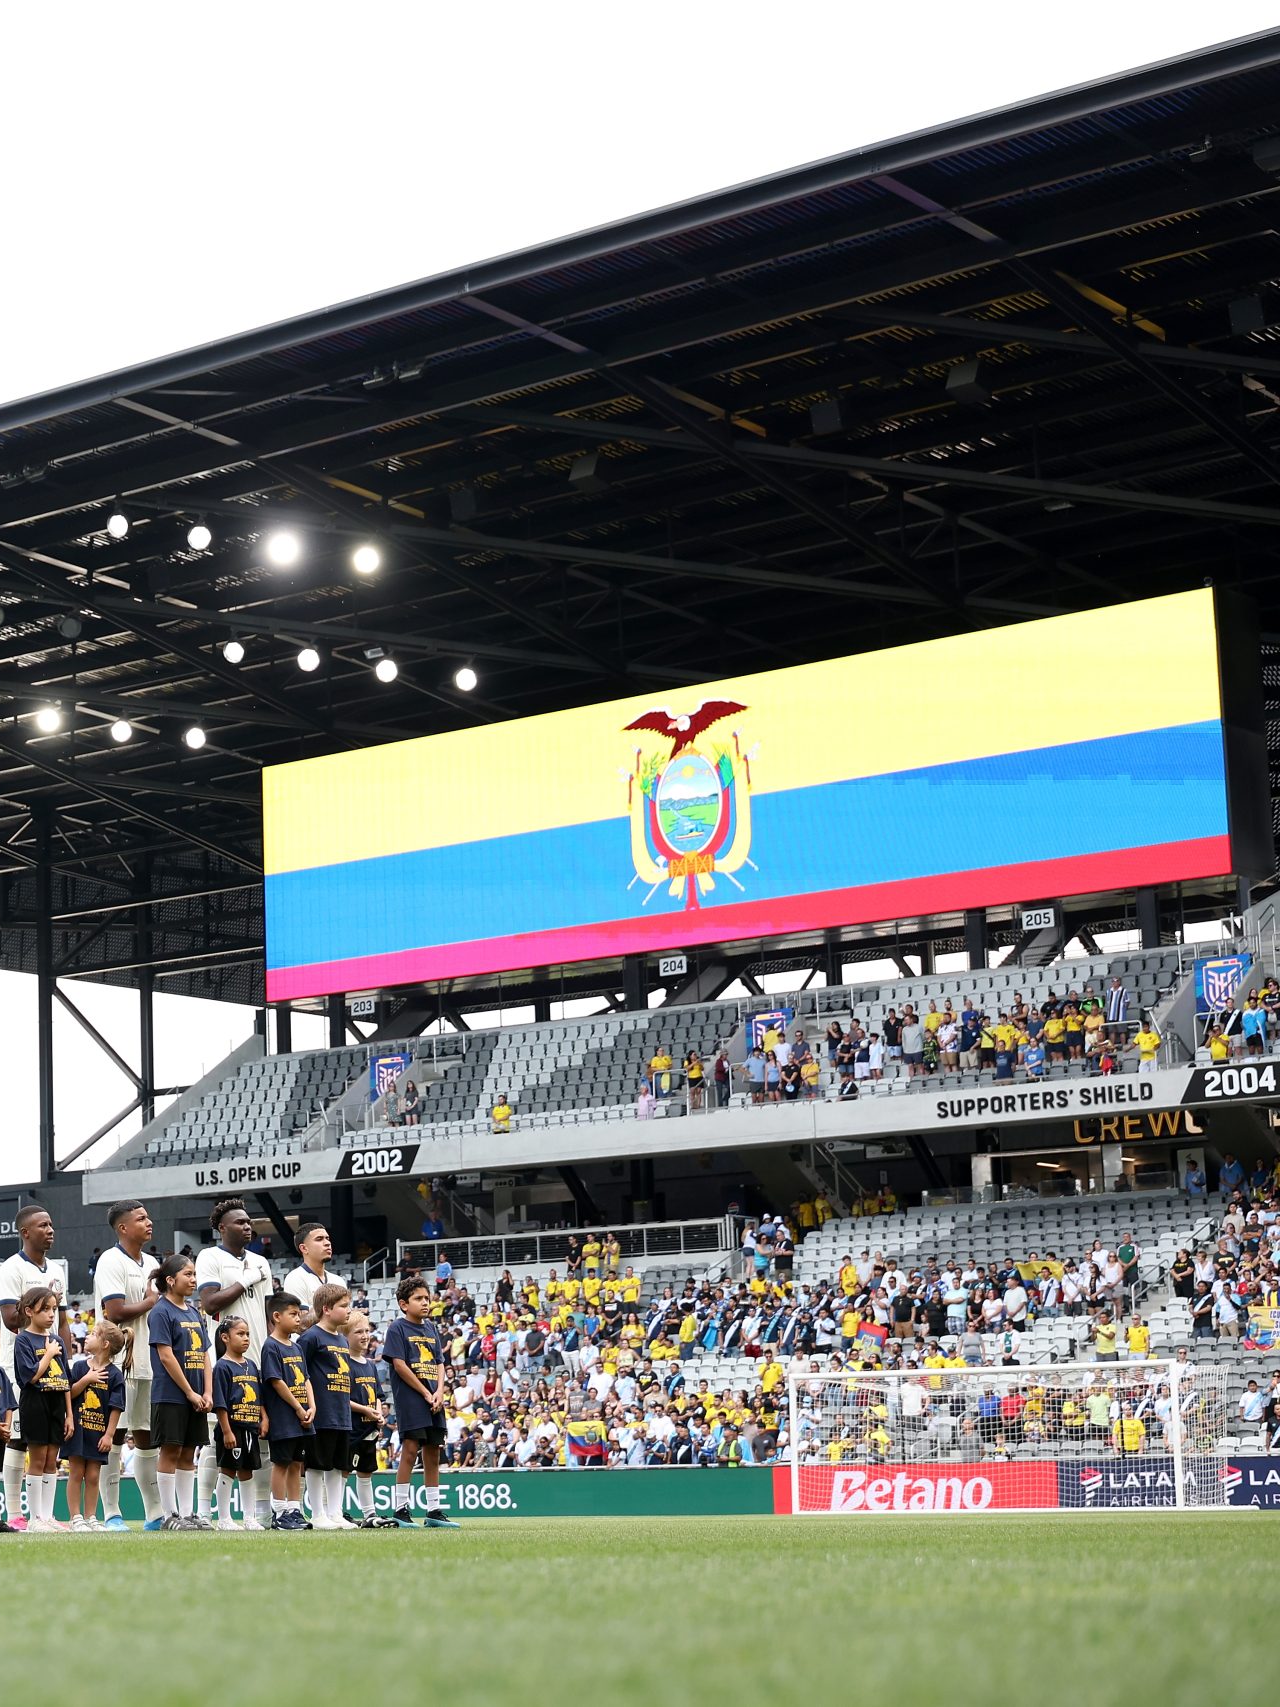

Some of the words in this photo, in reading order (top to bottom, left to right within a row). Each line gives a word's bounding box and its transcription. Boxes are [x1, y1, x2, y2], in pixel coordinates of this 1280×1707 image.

[1025, 912, 1052, 928] 205
[662, 958, 685, 974] 204
[353, 1000, 372, 1013] 203
[1204, 1065, 1277, 1098] 2004
[936, 1089, 1074, 1119] SUPPORTERS'
[1079, 1082, 1153, 1105] SHIELD
[1073, 1111, 1181, 1144] CREW
[195, 1170, 223, 1187] U.S.
[228, 1165, 267, 1183] OPEN
[272, 1162, 301, 1179] CUP
[351, 1149, 404, 1176] 2002
[455, 1483, 518, 1511] 1868.
[830, 1470, 993, 1511] Betano
[1109, 1494, 1199, 1507] AIRLINS
